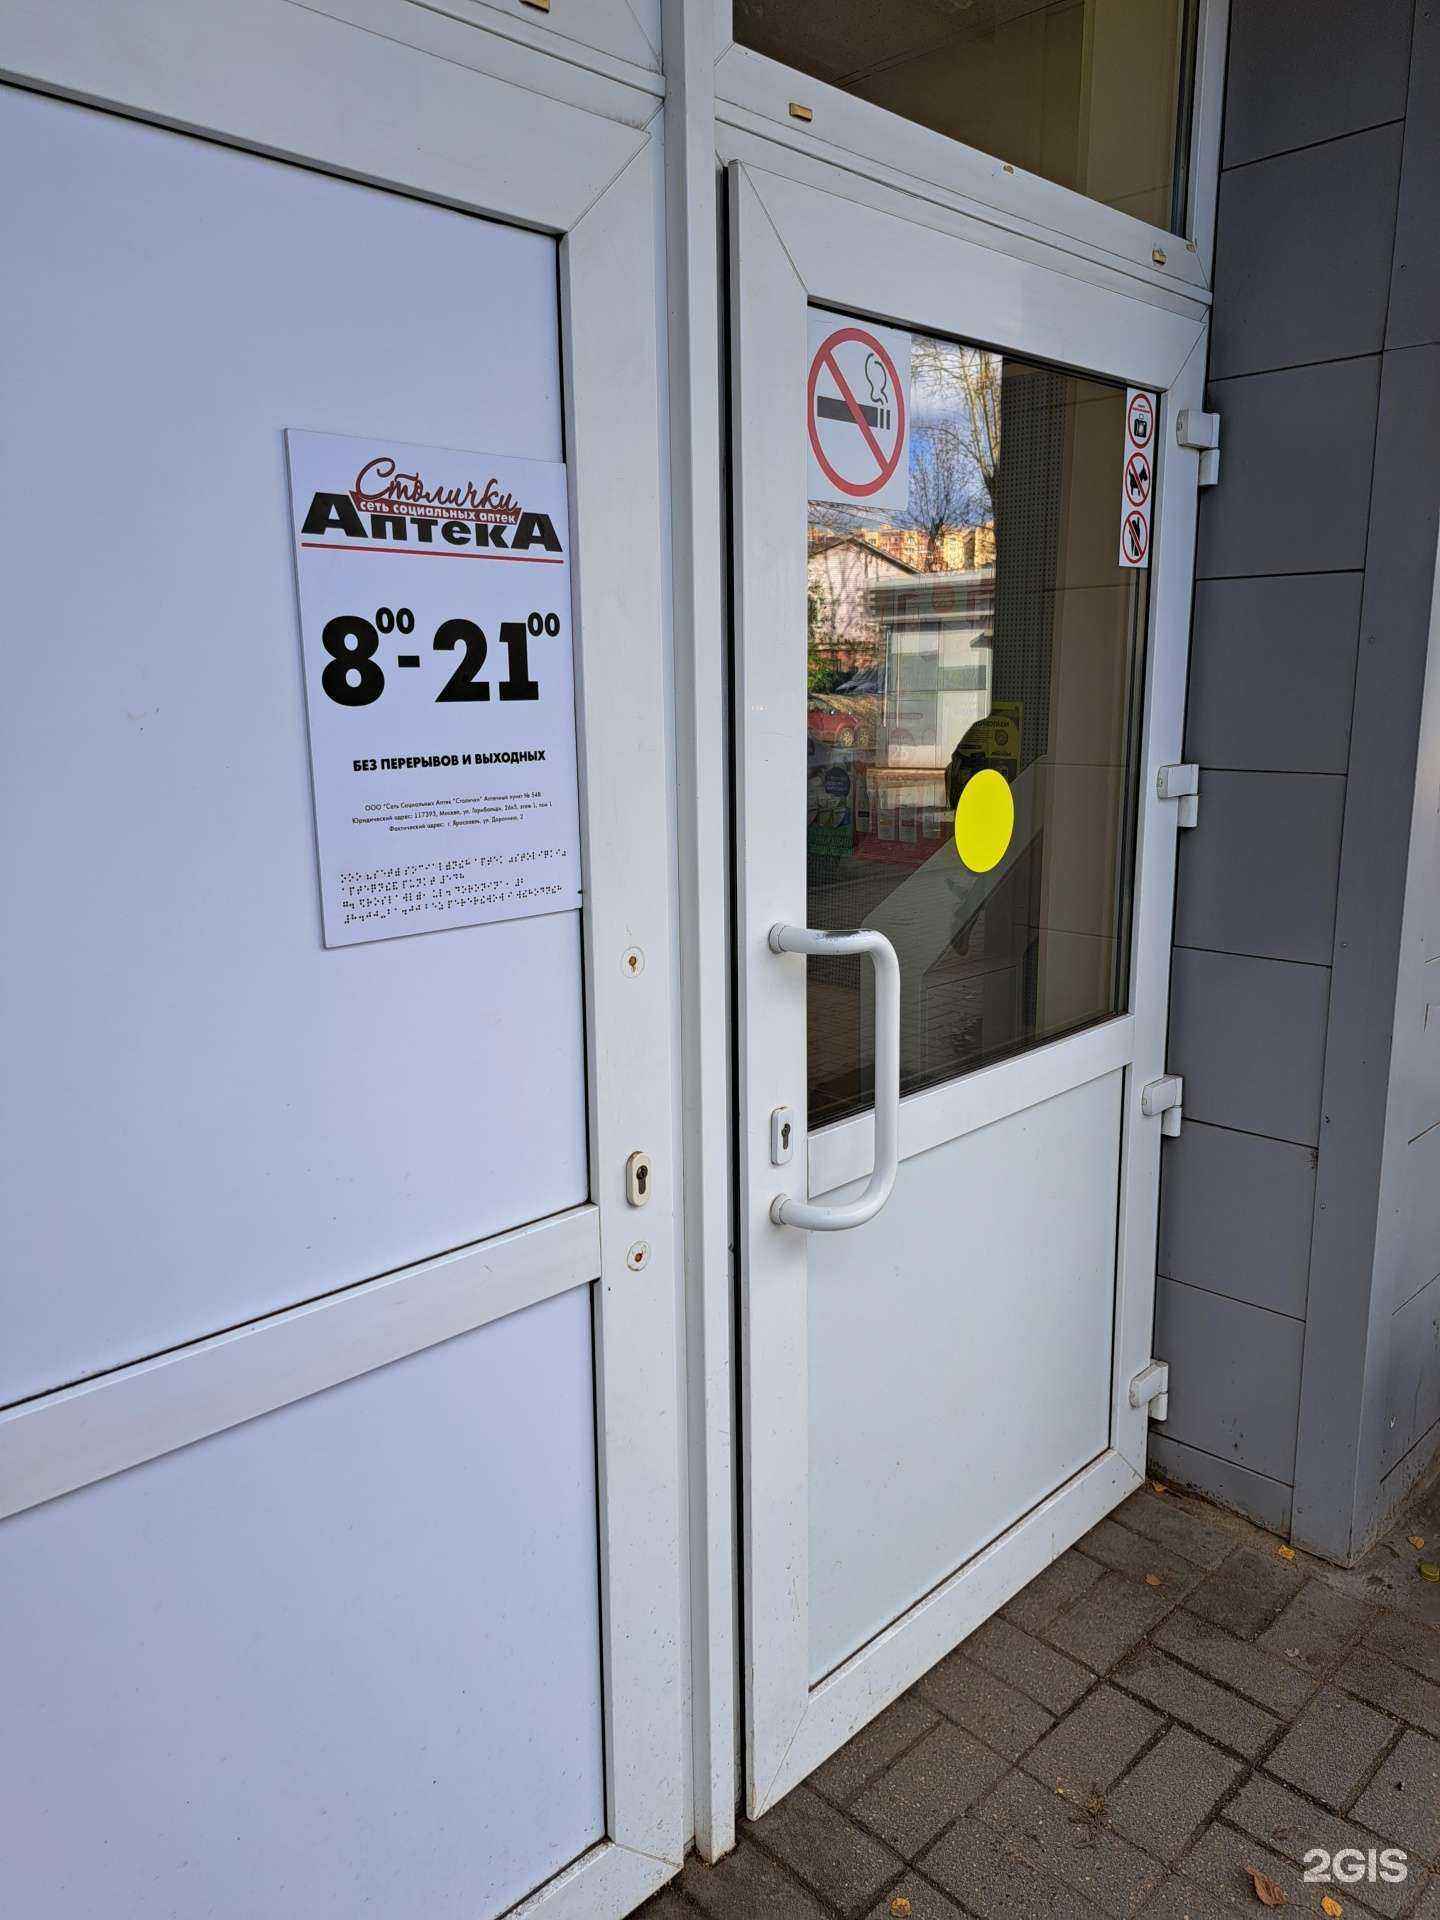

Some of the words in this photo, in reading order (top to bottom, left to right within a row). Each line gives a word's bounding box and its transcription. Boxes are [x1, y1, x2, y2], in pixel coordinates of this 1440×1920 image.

[356, 457, 520, 511] Столички
[359, 500, 390, 513] сеть
[393, 503, 476, 521] социальных
[479, 511, 517, 525] аптек
[353, 759, 378, 772] БЕЗ
[381, 754, 459, 769] ПЕРЕРЫВОВ
[462, 752, 472, 765] И
[475, 750, 546, 764] ВЫХОДНЫХ
[364, 803, 382, 811] ООО
